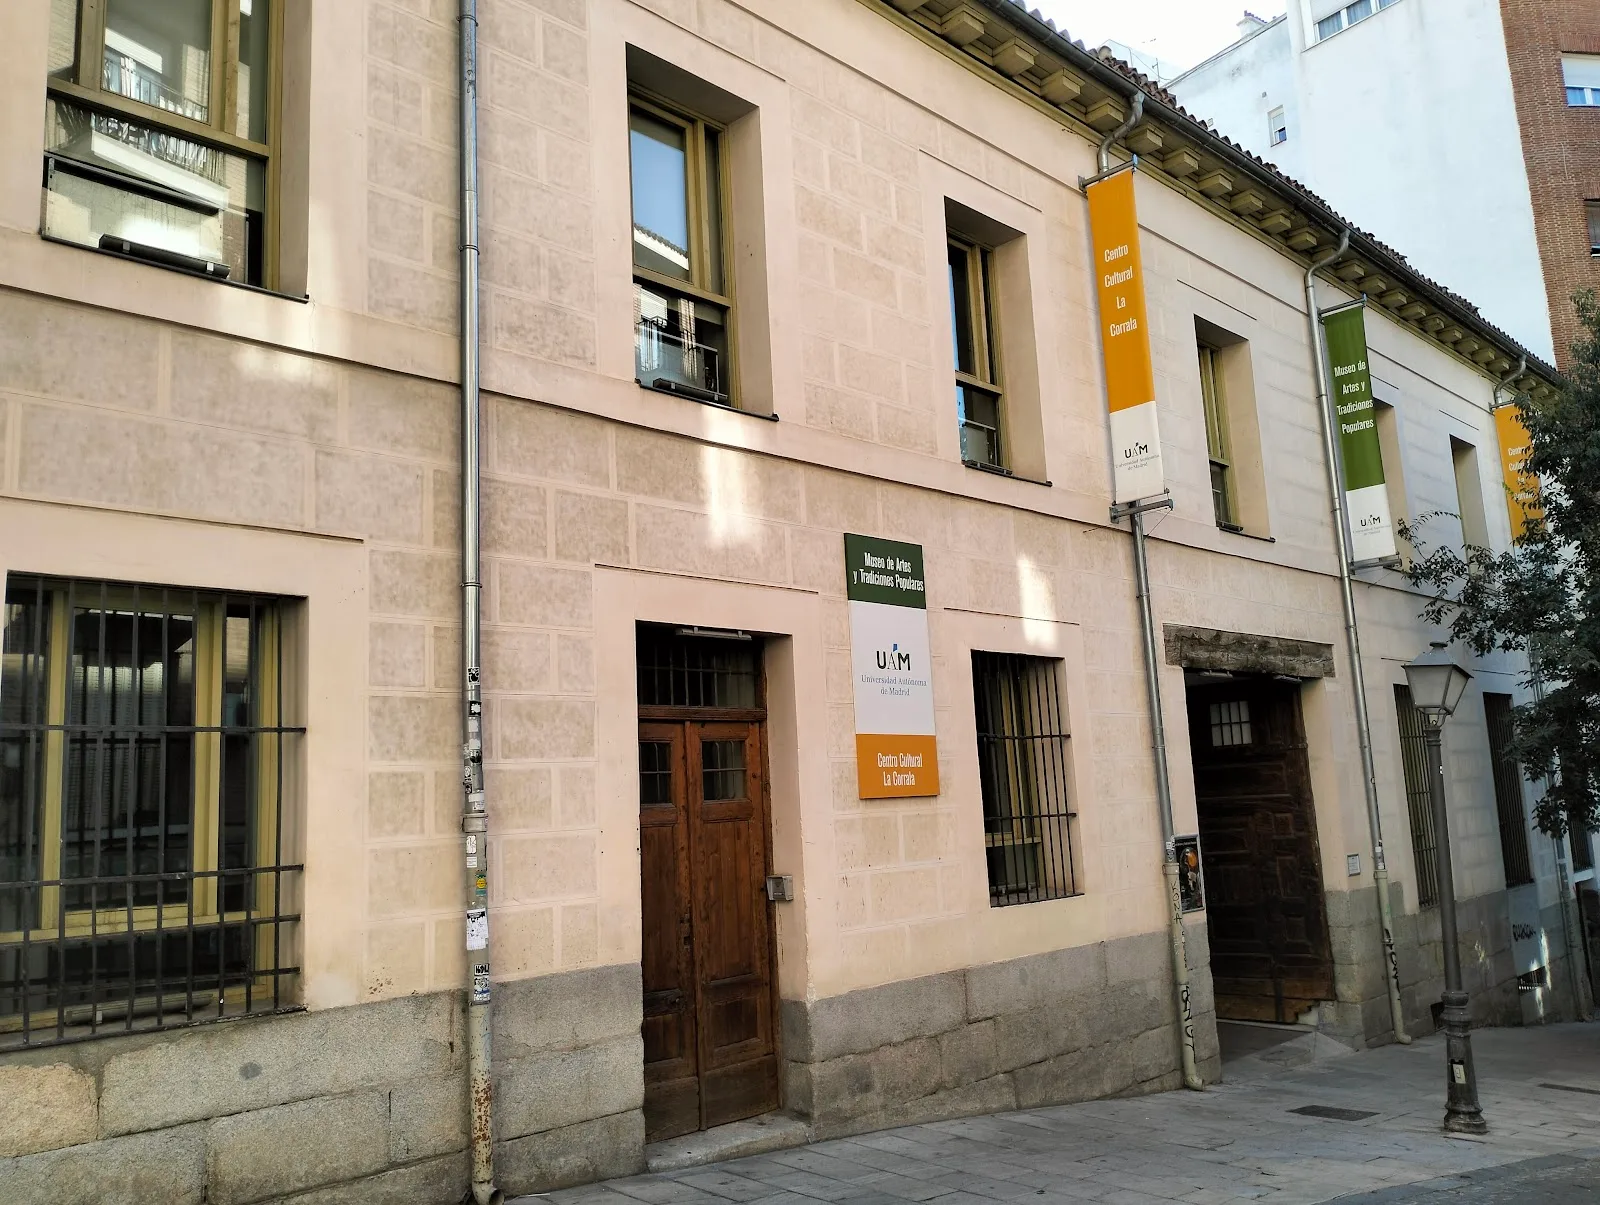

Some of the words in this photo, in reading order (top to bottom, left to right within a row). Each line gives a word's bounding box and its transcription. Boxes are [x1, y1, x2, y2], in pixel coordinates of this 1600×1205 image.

[1104, 244, 1129, 263] Centro
[1104, 266, 1133, 288] Cultural
[1116, 296, 1126, 309] La
[1109, 317, 1138, 337] Corrala
[1334, 364, 1357, 377] Museo
[1357, 360, 1367, 371] de
[1342, 382, 1360, 395] Artes
[1361, 381, 1366, 392] y
[1336, 399, 1374, 416] Tradiciones
[1341, 419, 1374, 435] Populares
[864, 552, 885, 569] Museo
[886, 556, 895, 570] de
[896, 557, 912, 573] Artes
[852, 571, 858, 584] y
[859, 568, 894, 588] Tradiciones
[895, 574, 924, 592] Populares
[861, 674, 897, 685] Universidad
[880, 687, 888, 695] de
[889, 687, 910, 696] Madrid
[877, 752, 898, 768] Centro
[899, 752, 923, 768] Cultural
[883, 770, 892, 786] La
[892, 770, 916, 786] Corrala
